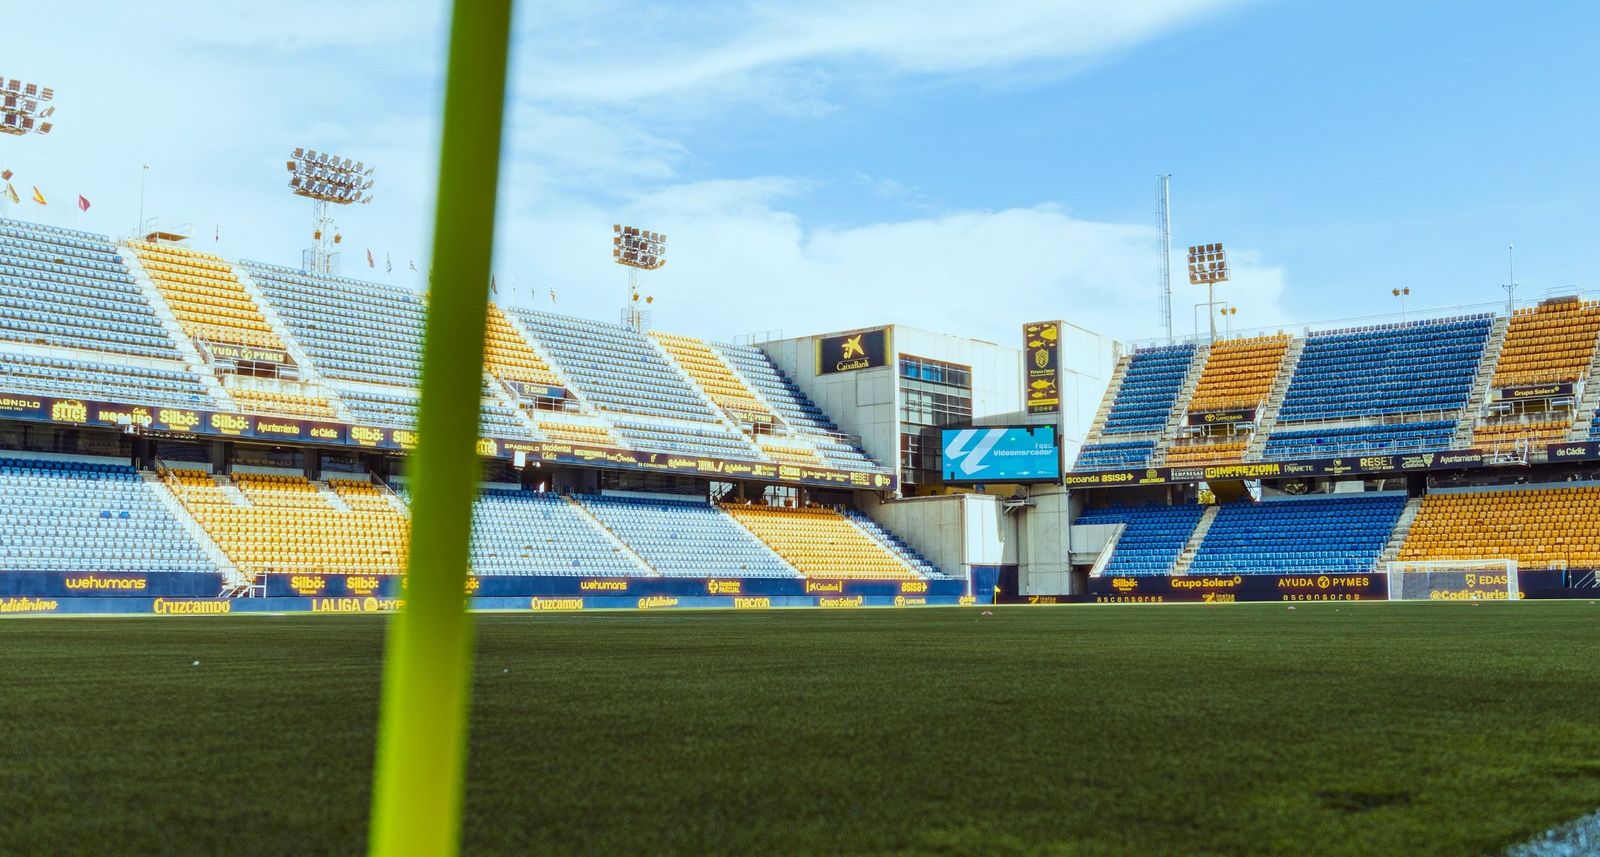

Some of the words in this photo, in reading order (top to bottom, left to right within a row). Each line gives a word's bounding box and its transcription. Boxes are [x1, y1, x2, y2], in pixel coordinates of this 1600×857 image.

[253, 351, 284, 362] PYMES
[836, 359, 870, 371] CaixaBank
[1514, 389, 1534, 397] Grupo
[257, 421, 300, 435] Ayuntamiento
[310, 427, 319, 437] de
[1556, 448, 1566, 457] de
[1566, 447, 1586, 456] Cádiz
[1360, 456, 1394, 468] RESET
[1440, 453, 1482, 465] Ayuntamiento
[1216, 463, 1280, 477] IMPREZIONA
[850, 472, 870, 482] RESET
[1072, 475, 1100, 485] coanda
[1101, 473, 1127, 484] asisa
[66, 576, 147, 589] wehumans
[580, 580, 628, 590] wehumans
[1171, 578, 1202, 589] Grupo
[1202, 577, 1234, 588] Solera
[1278, 578, 1314, 588] AYUDA
[1332, 577, 1369, 588] PYMES
[1479, 575, 1507, 585] EDAS
[901, 583, 922, 592] asisa
[1096, 595, 1163, 603] ascensores
[1283, 593, 1360, 601] ascensores
[1429, 589, 1526, 600] @CadizTuriso
[153, 597, 231, 614] Cruzcampo
[312, 598, 361, 612] LALIGA
[379, 599, 405, 610] HYP
[531, 596, 584, 610] Cruzcampo
[734, 597, 770, 609] macron
[819, 597, 839, 608] Grupo
